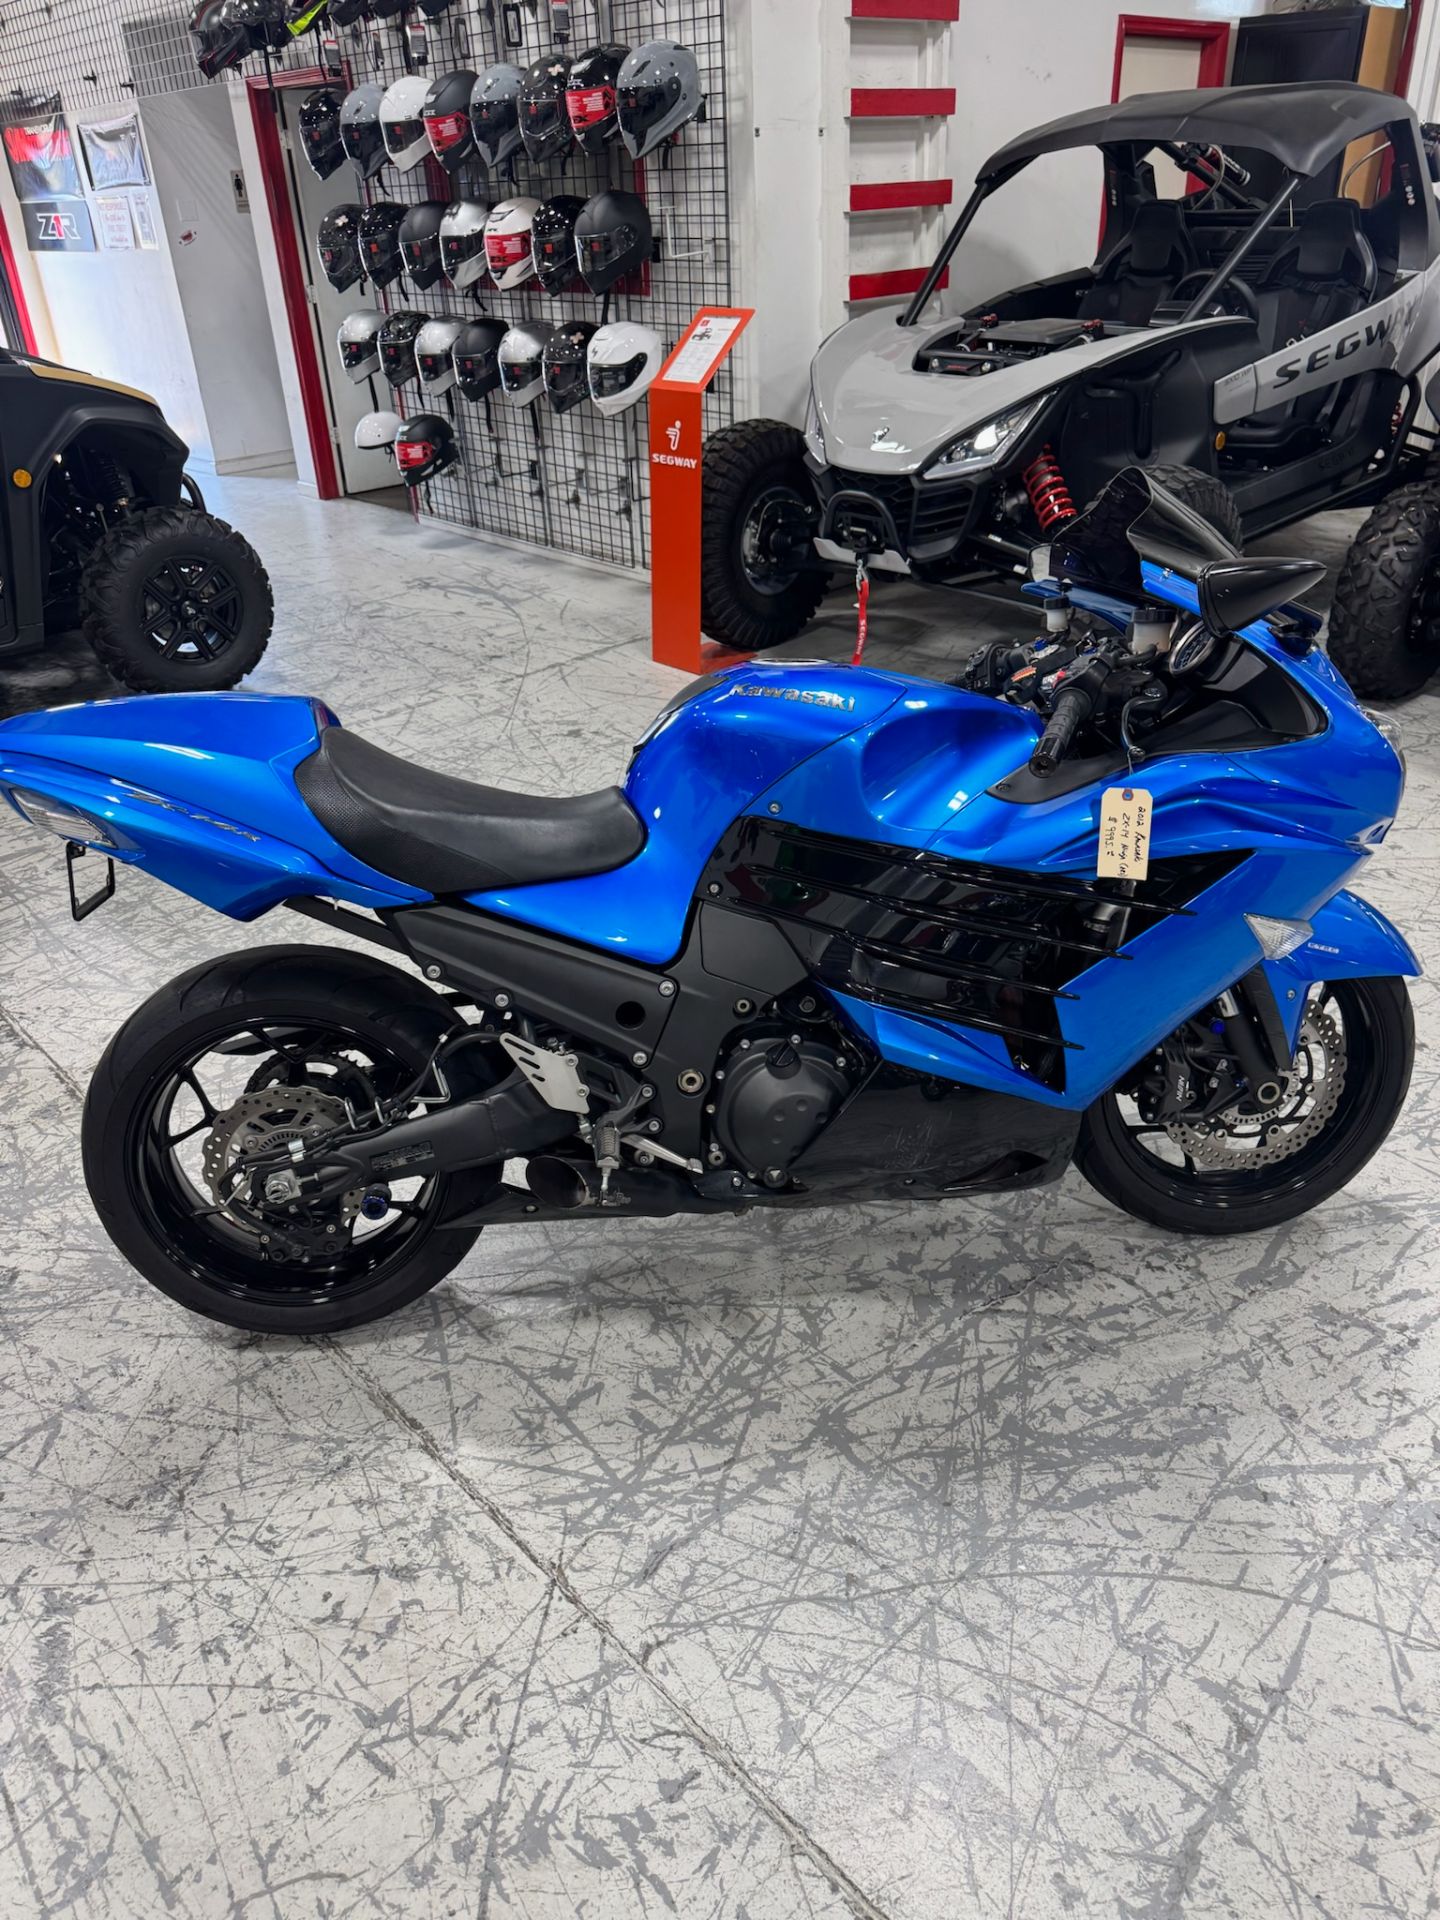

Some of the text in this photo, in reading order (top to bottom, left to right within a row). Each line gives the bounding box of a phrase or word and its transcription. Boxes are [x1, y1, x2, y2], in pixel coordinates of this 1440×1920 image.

[36, 213, 81, 240] Z1R
[652, 453, 698, 469] SEGWAY
[855, 618, 867, 656] SEGWAY
[728, 682, 856, 712] Kawasaki
[1121, 812, 1131, 838] ZX-14
[1137, 806, 1146, 826] 2012
